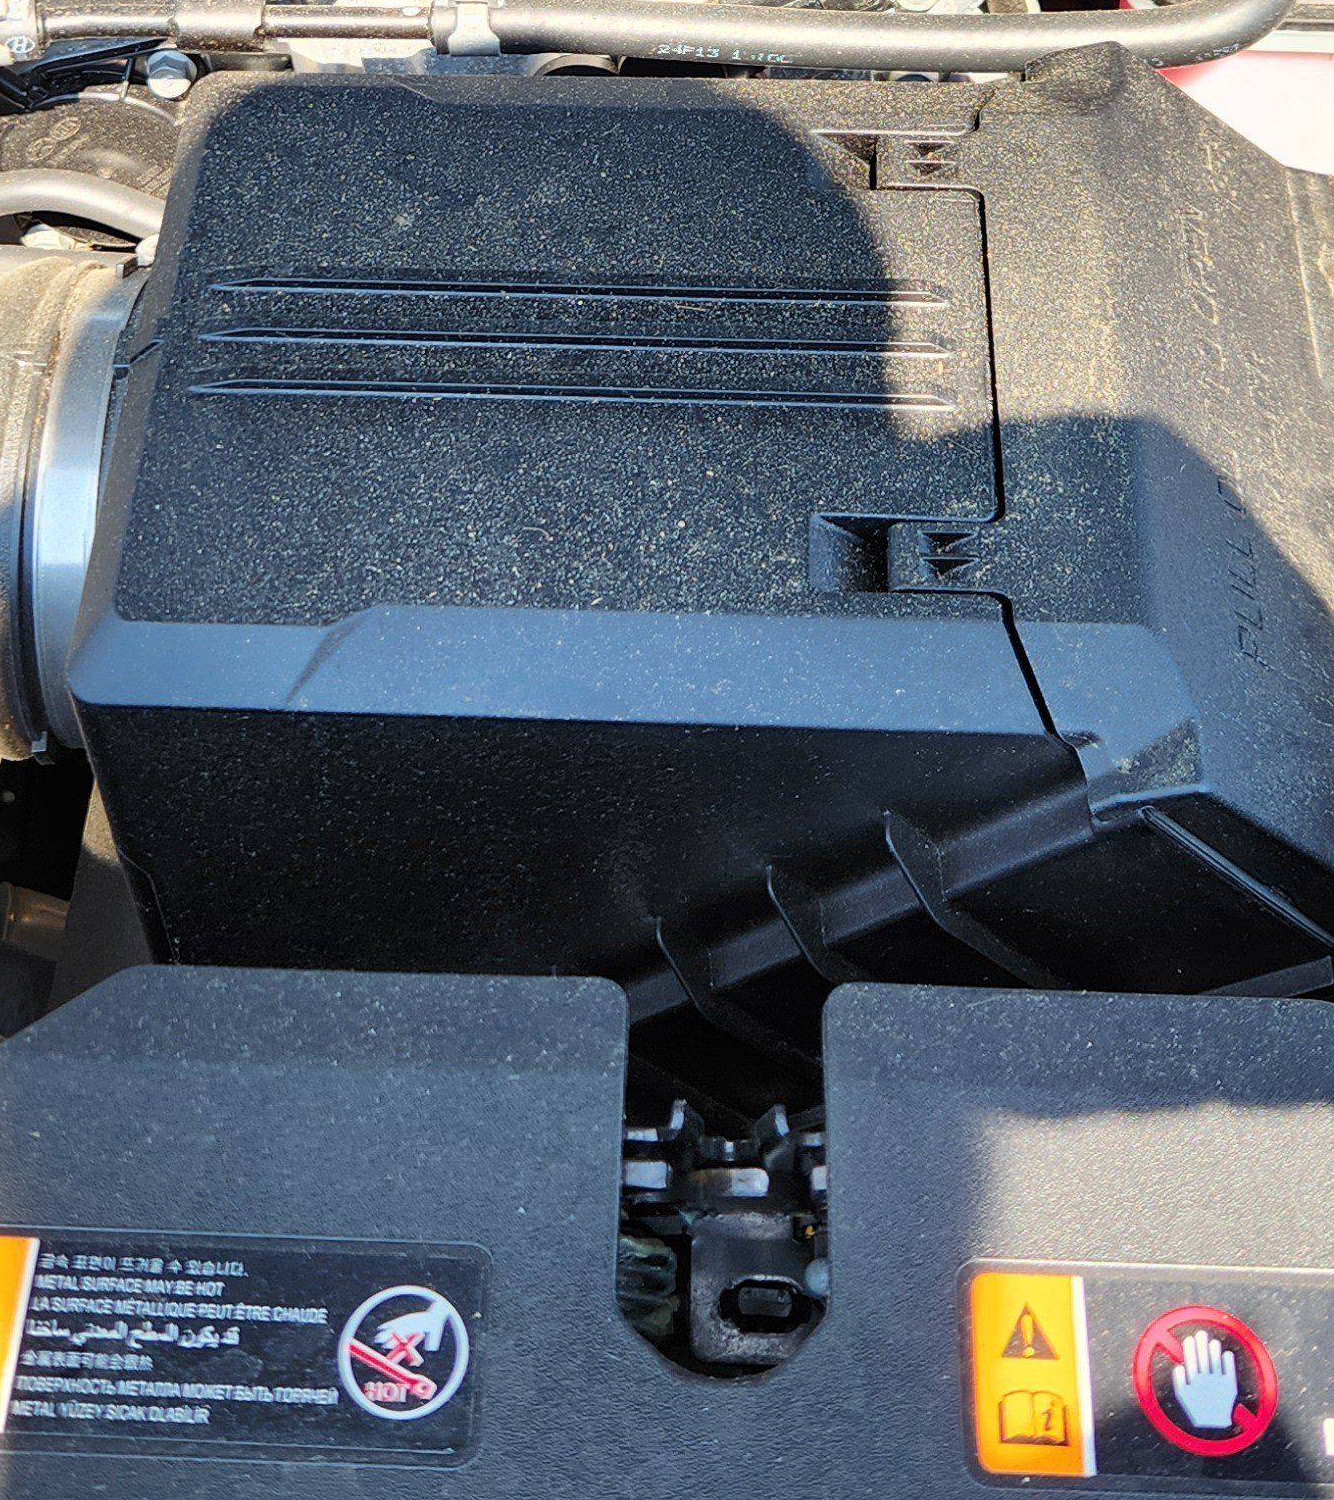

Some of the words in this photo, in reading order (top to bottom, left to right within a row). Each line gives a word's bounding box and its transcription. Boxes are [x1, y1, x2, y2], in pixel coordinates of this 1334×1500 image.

[34, 1272, 79, 1291] METAL
[79, 1274, 145, 1294] SURFACE
[144, 1277, 172, 1295] MAY
[172, 1279, 195, 1296] BE
[195, 1279, 225, 1298] HOT
[30, 1294, 52, 1312] LA
[50, 1294, 114, 1315] SURFACE
[196, 1302, 233, 1320] PEUT
[271, 1305, 328, 1324] CHAUDE
[15, 1374, 117, 1396] ПОВЕРХНОСТЬ
[182, 1381, 231, 1401] МОЖЕТ
[362, 1379, 408, 1405] HOT
[10, 1398, 57, 1418] METAL
[102, 1402, 147, 1422] SICAK
